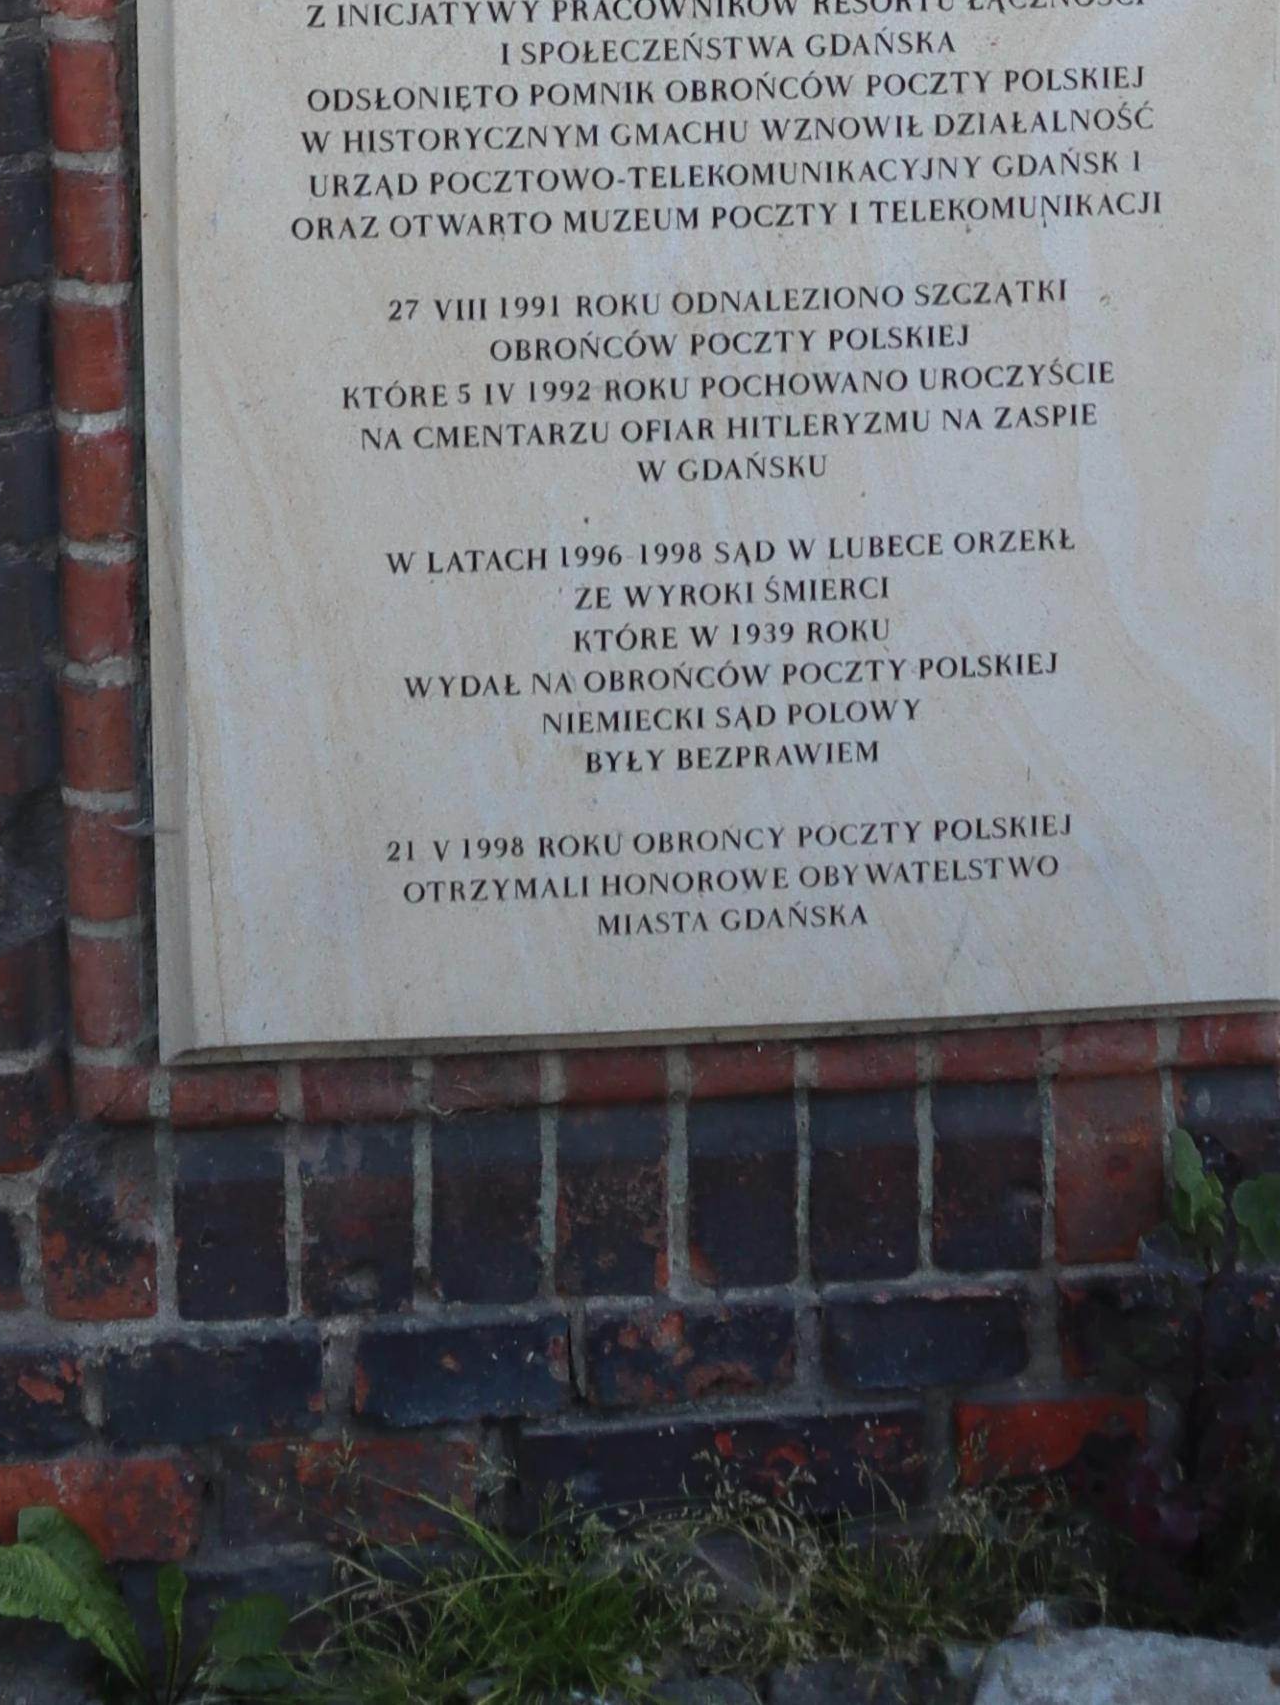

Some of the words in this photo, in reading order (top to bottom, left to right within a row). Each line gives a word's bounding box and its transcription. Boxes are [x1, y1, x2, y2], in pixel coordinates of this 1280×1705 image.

[307, 84, 519, 113] ODSŁONIĘTO
[530, 80, 655, 107] POMNIK
[665, 70, 853, 103] OBROŃCÓW
[866, 70, 991, 98] POCZTY
[1004, 65, 1144, 93] POLSKIEJ
[300, 130, 331, 154] W
[343, 124, 599, 154] HISTORYCZNYM
[610, 119, 748, 147] GMACHU
[760, 114, 924, 142] WZNOWIŁ
[934, 100, 1154, 137] DZIAŁALNOŚĆ
[388, 298, 419, 322] 27
[433, 297, 487, 322] VIII
[500, 294, 559, 319] 1991
[576, 293, 659, 318] ROKU
[671, 285, 904, 315] ODNALEZIONO
[914, 278, 1067, 308] SZCZĄTKI
[489, 329, 678, 362] OBROŃCÓW
[690, 329, 815, 357] POCZTY
[829, 323, 969, 352] POLSKIEJ
[361, 427, 403, 451] NA
[412, 421, 609, 450] CMENTARZU
[620, 417, 715, 444] OFIAR
[727, 409, 930, 440] HITLERYZMU
[942, 408, 983, 431] NA
[994, 402, 1097, 430] ZASPIE
[636, 459, 666, 483] W
[677, 451, 826, 482] GDAŃSKU
[574, 622, 678, 653] KTÓRE
[689, 625, 719, 648] W
[732, 622, 795, 646] 1939
[806, 618, 889, 644] ROKU
[403, 673, 521, 699] WYDAŁ
[532, 672, 573, 694] NA
[583, 659, 771, 693] OBROŃCÓW
[782, 658, 906, 686] POCZTY
[919, 651, 1058, 680] POLSKIEJ
[543, 707, 704, 735] NIEMIECKI
[715, 704, 777, 732] SĄD
[787, 698, 920, 726] POLOWY
[586, 749, 664, 774] BYŁY
[677, 740, 879, 771] BEZPRAWIEM
[403, 875, 589, 904] OTRZYMALI
[601, 867, 789, 897] HONOROWE
[798, 855, 1059, 888] OBYWATELSTWO
[598, 911, 709, 936] MIASTA
[720, 901, 868, 932] GDAŃSKA
